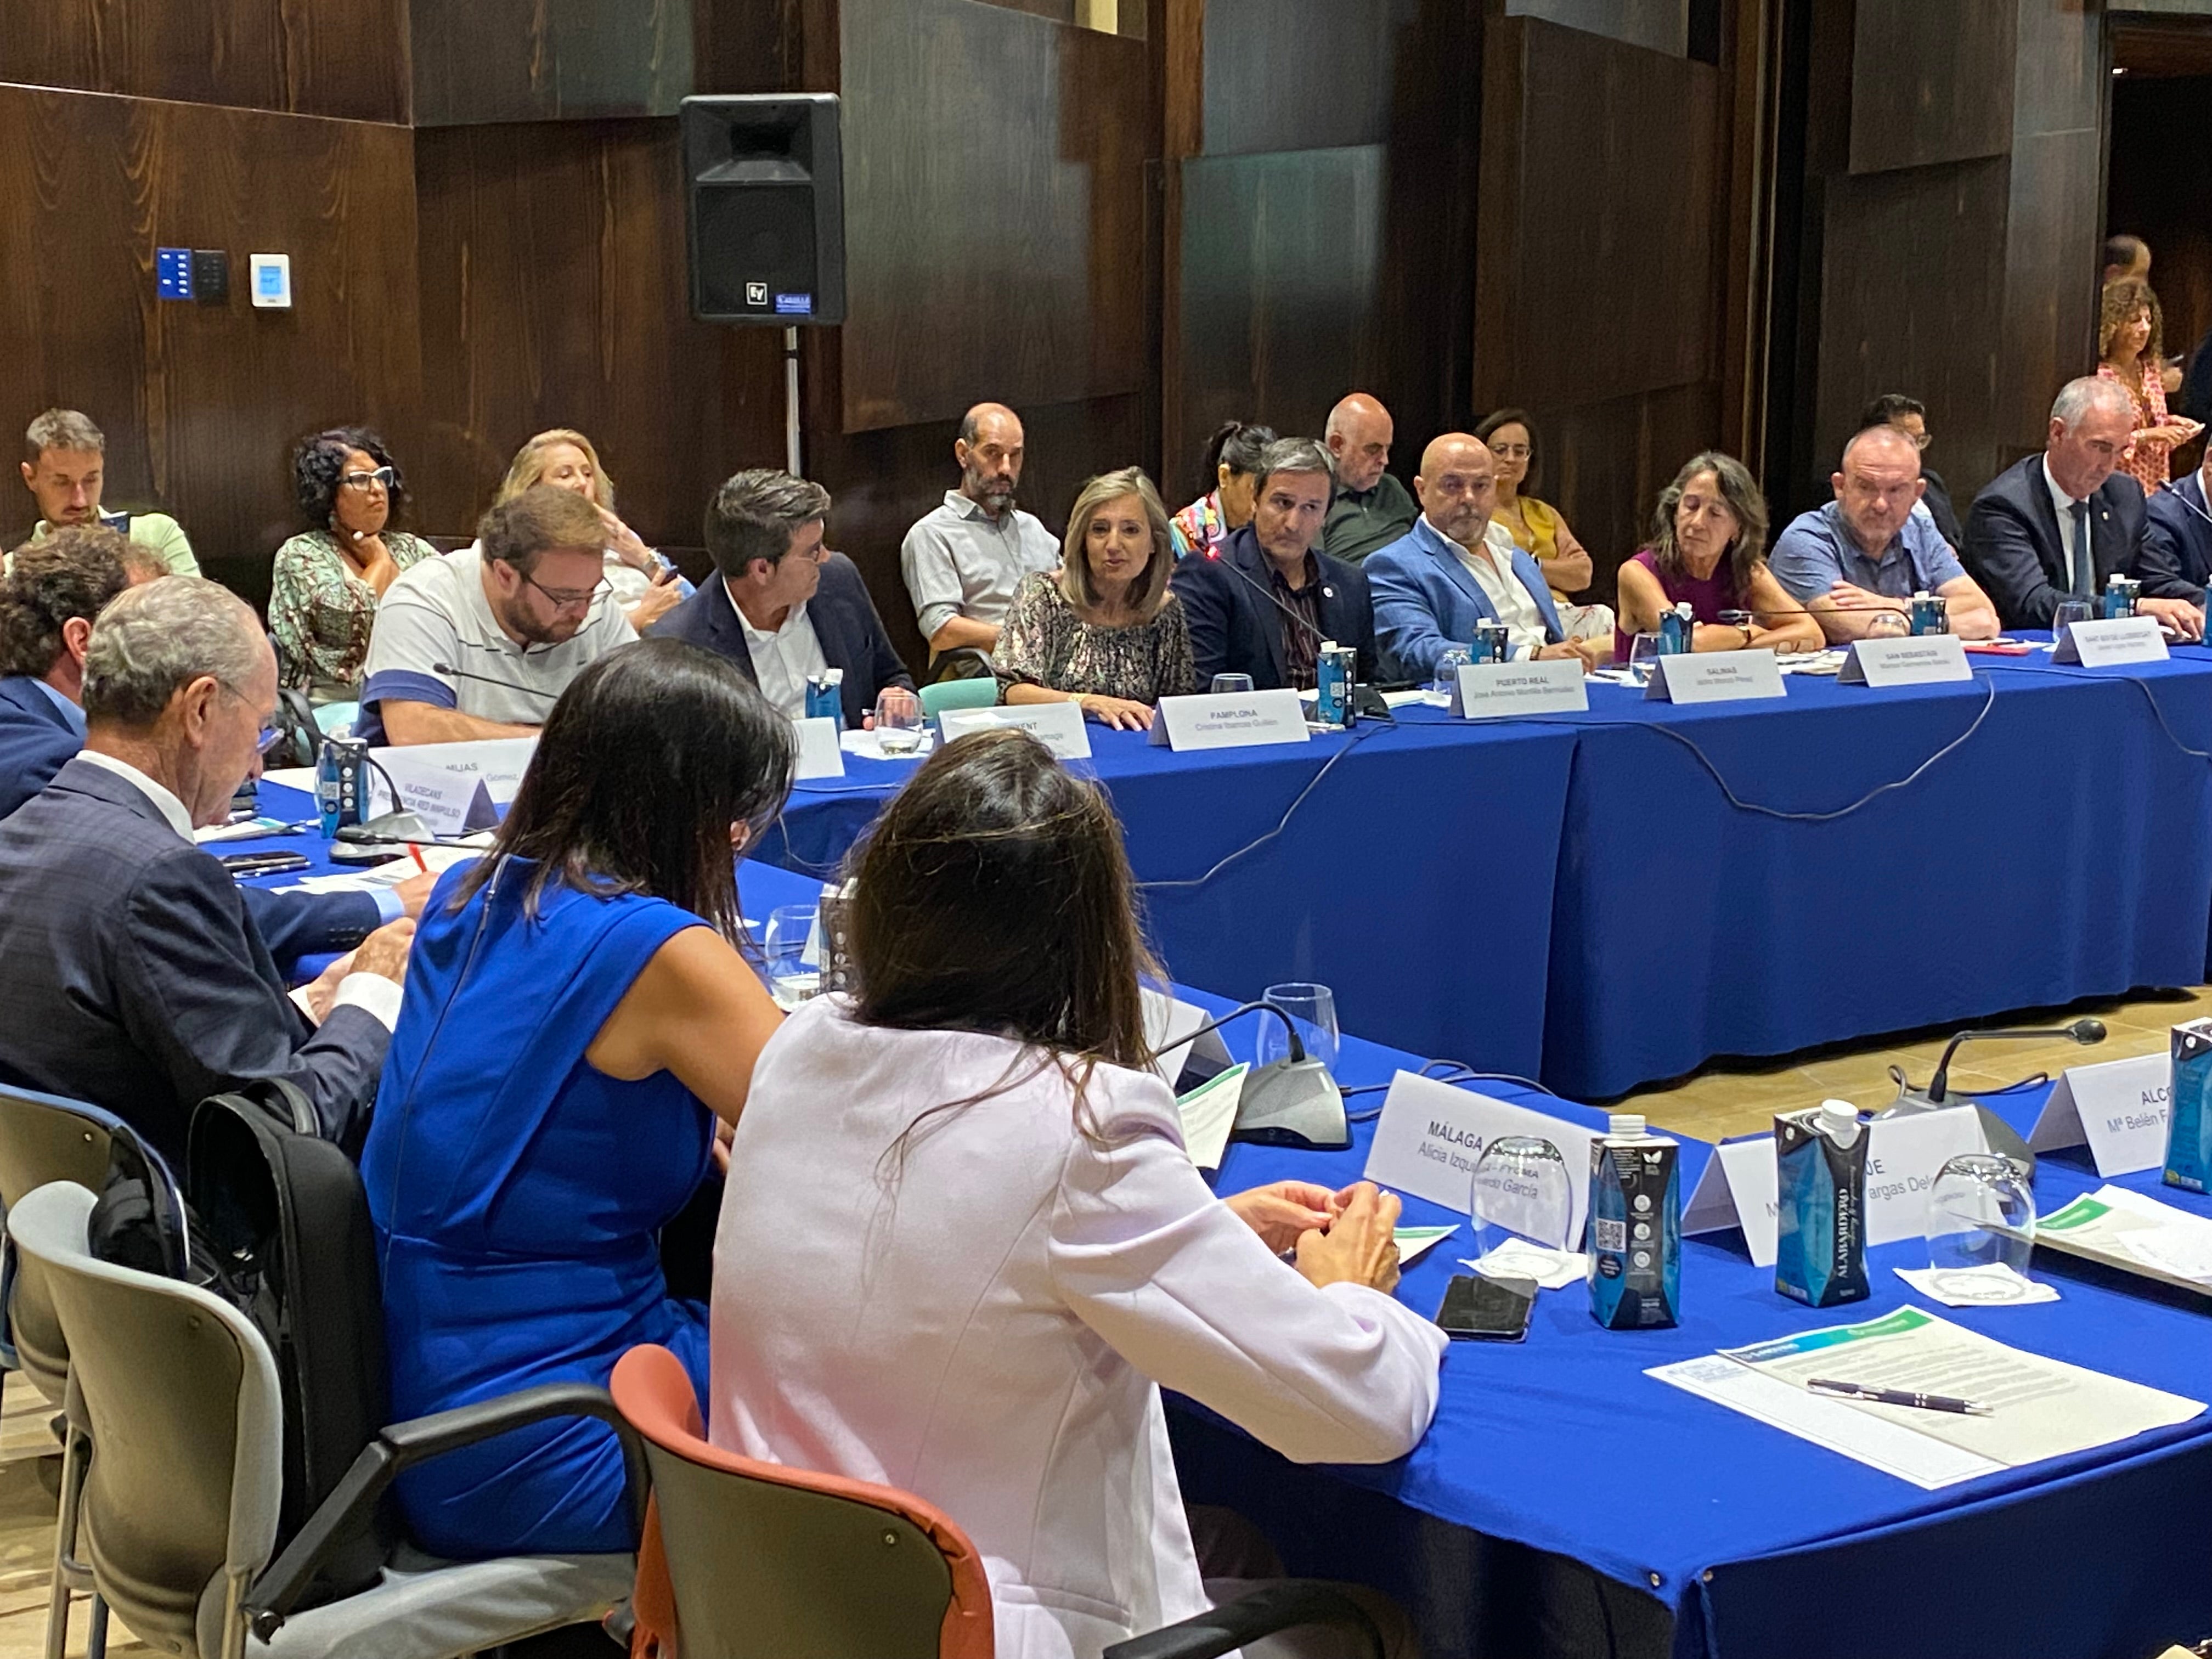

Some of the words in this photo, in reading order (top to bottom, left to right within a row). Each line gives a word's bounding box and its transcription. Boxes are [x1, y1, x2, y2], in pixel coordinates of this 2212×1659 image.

[1210, 709, 1257, 719] PAMPLONA
[2125, 1111, 2159, 1130] Belén
[1427, 1121, 1483, 1152] MÁLAGA
[1418, 1141, 1447, 1163] Alicia
[1868, 1182, 1906, 1201] argas
